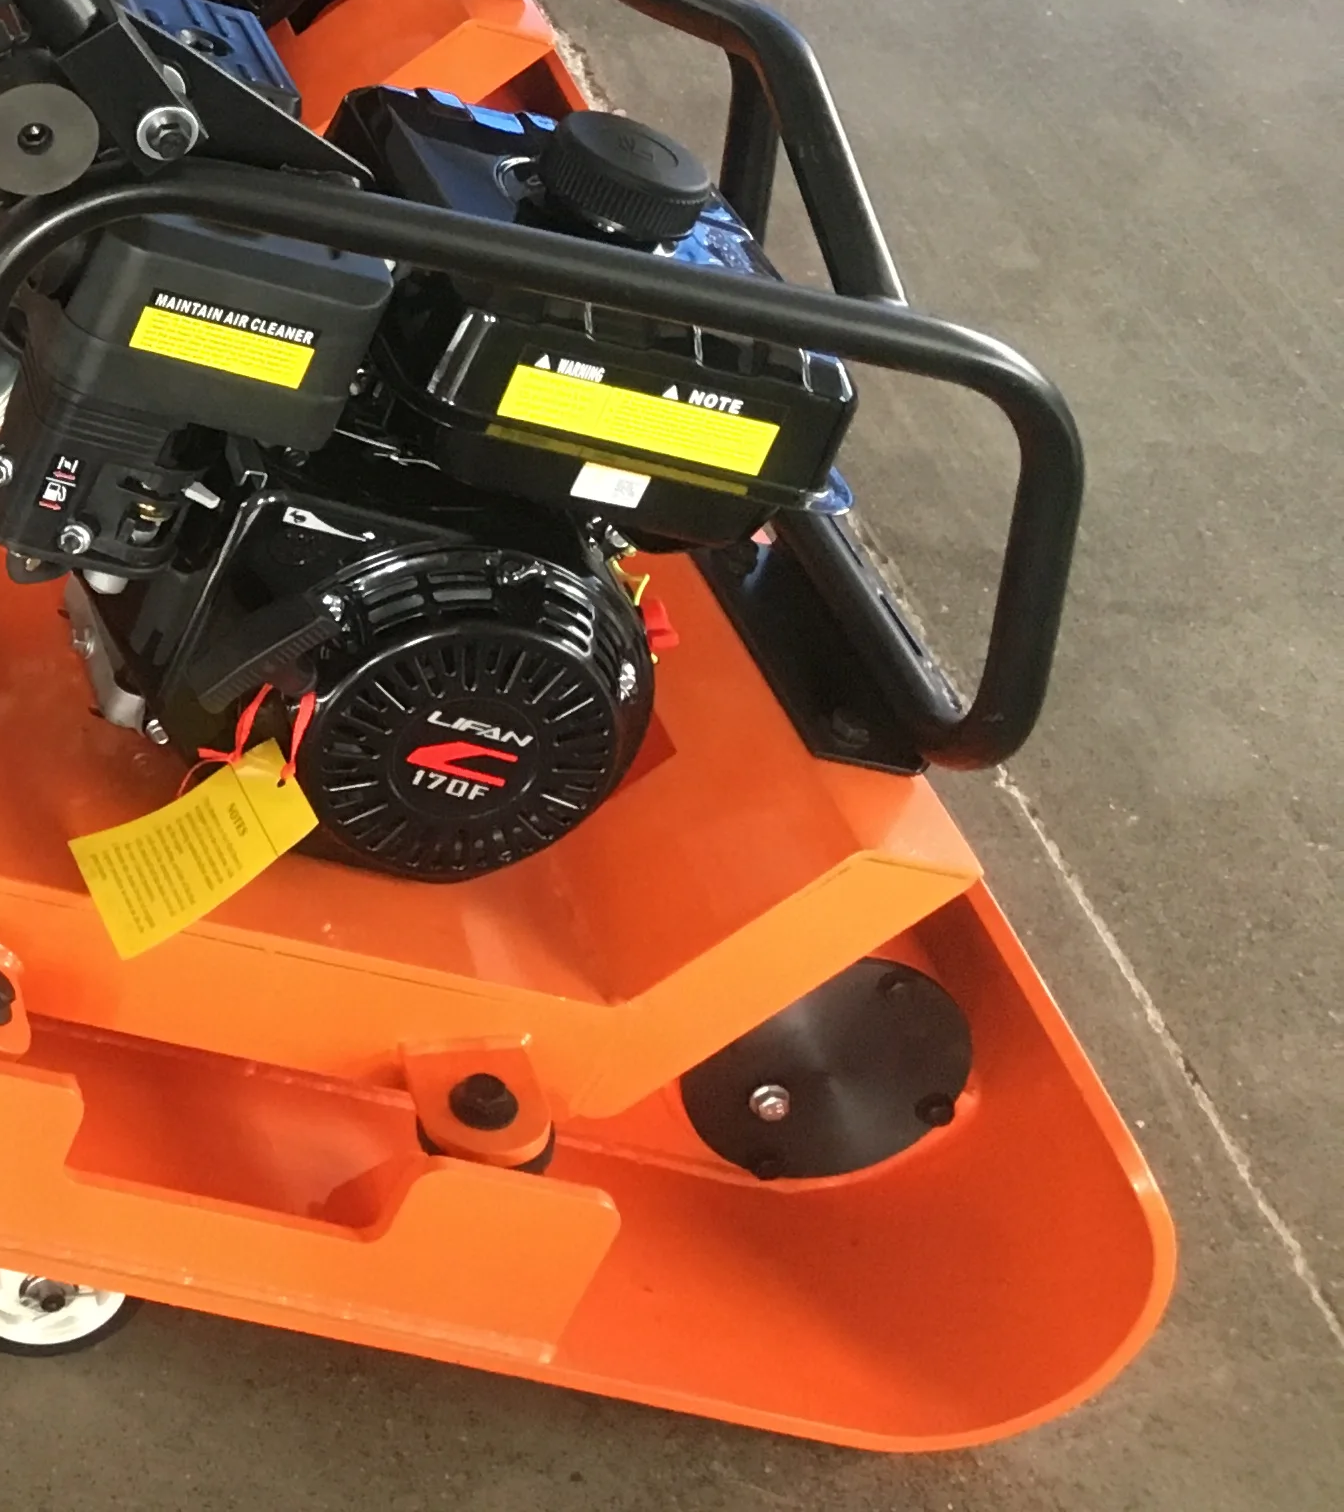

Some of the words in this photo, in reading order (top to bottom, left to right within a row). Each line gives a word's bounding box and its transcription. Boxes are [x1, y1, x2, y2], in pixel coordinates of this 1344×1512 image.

[154, 293, 224, 322] MAINTAIN
[223, 311, 251, 329] AIR
[250, 317, 315, 345] CLEANER
[556, 358, 606, 383] WARNING
[688, 389, 744, 415] NOTE
[427, 710, 534, 747] LIFAN
[412, 769, 490, 800] 170F
[226, 802, 249, 838] NOTES
